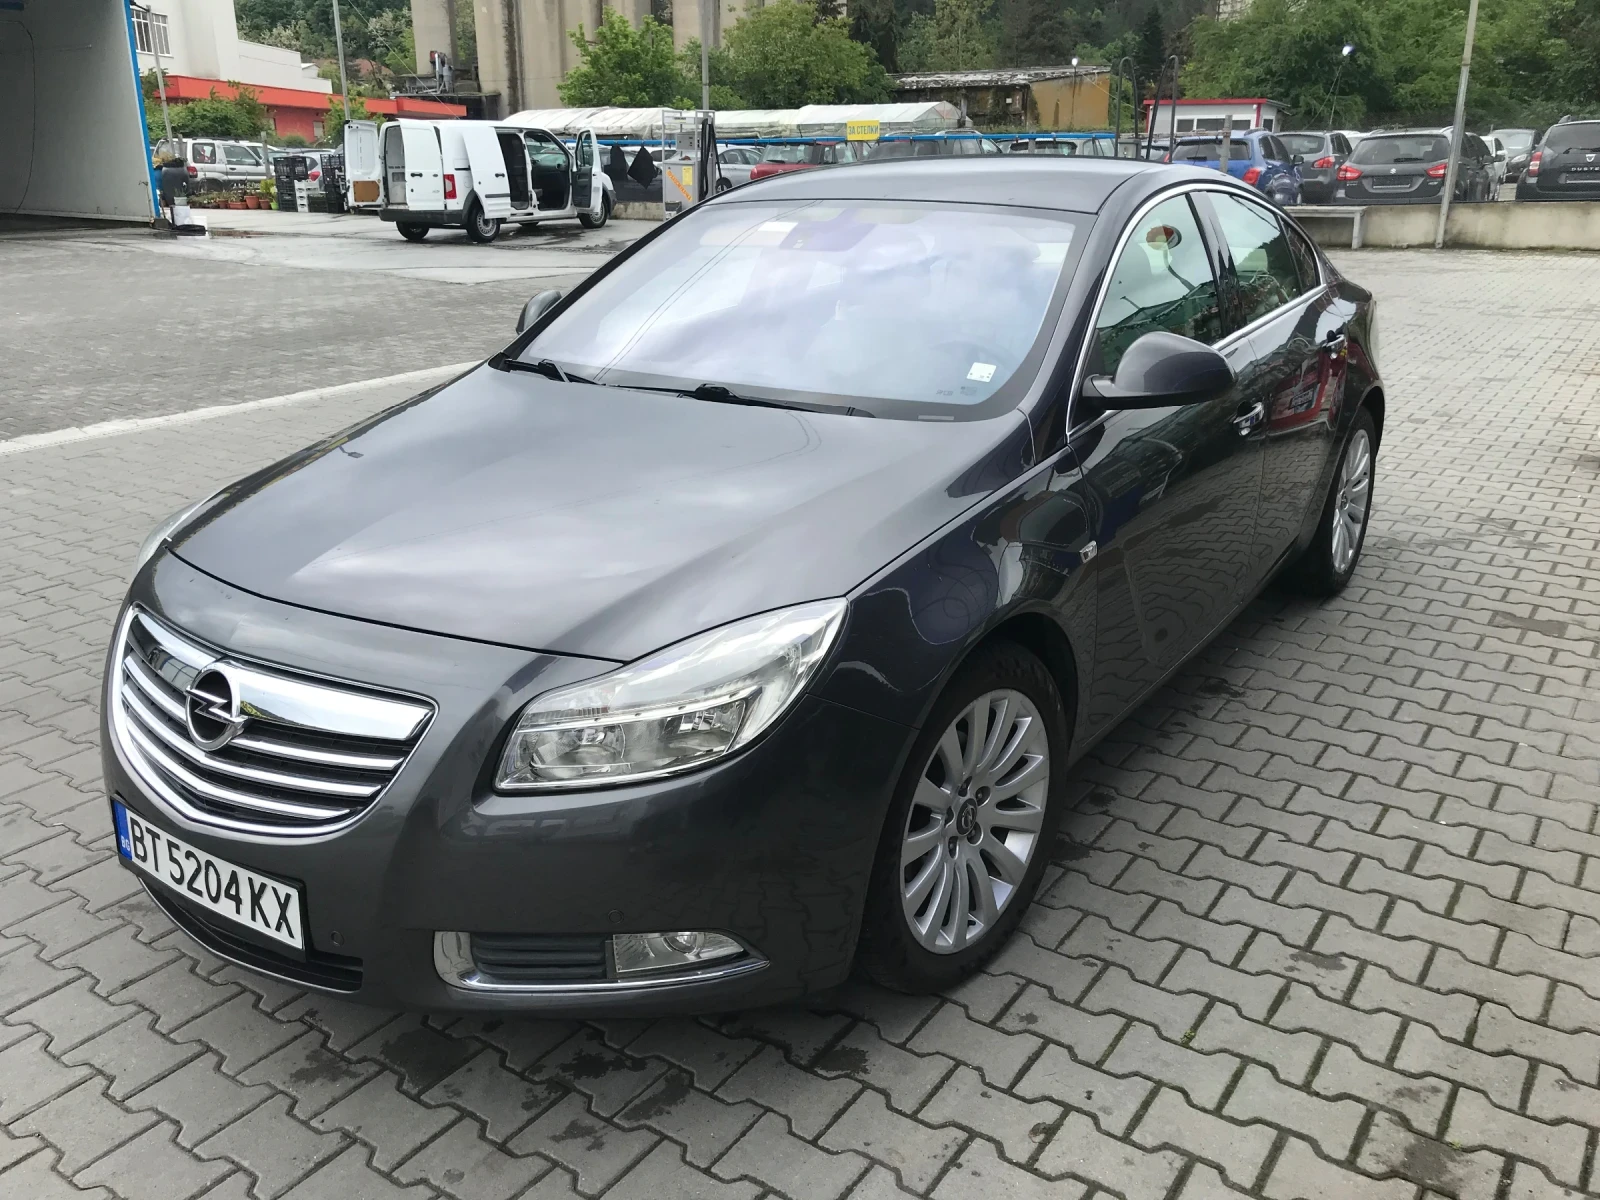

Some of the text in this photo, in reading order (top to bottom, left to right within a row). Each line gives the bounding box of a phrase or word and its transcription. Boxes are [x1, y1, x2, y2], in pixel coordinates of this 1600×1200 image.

[848, 125, 878, 135] ЗА СТЕЛКИ
[121, 835, 131, 851] BG
[166, 838, 243, 916] 5204
